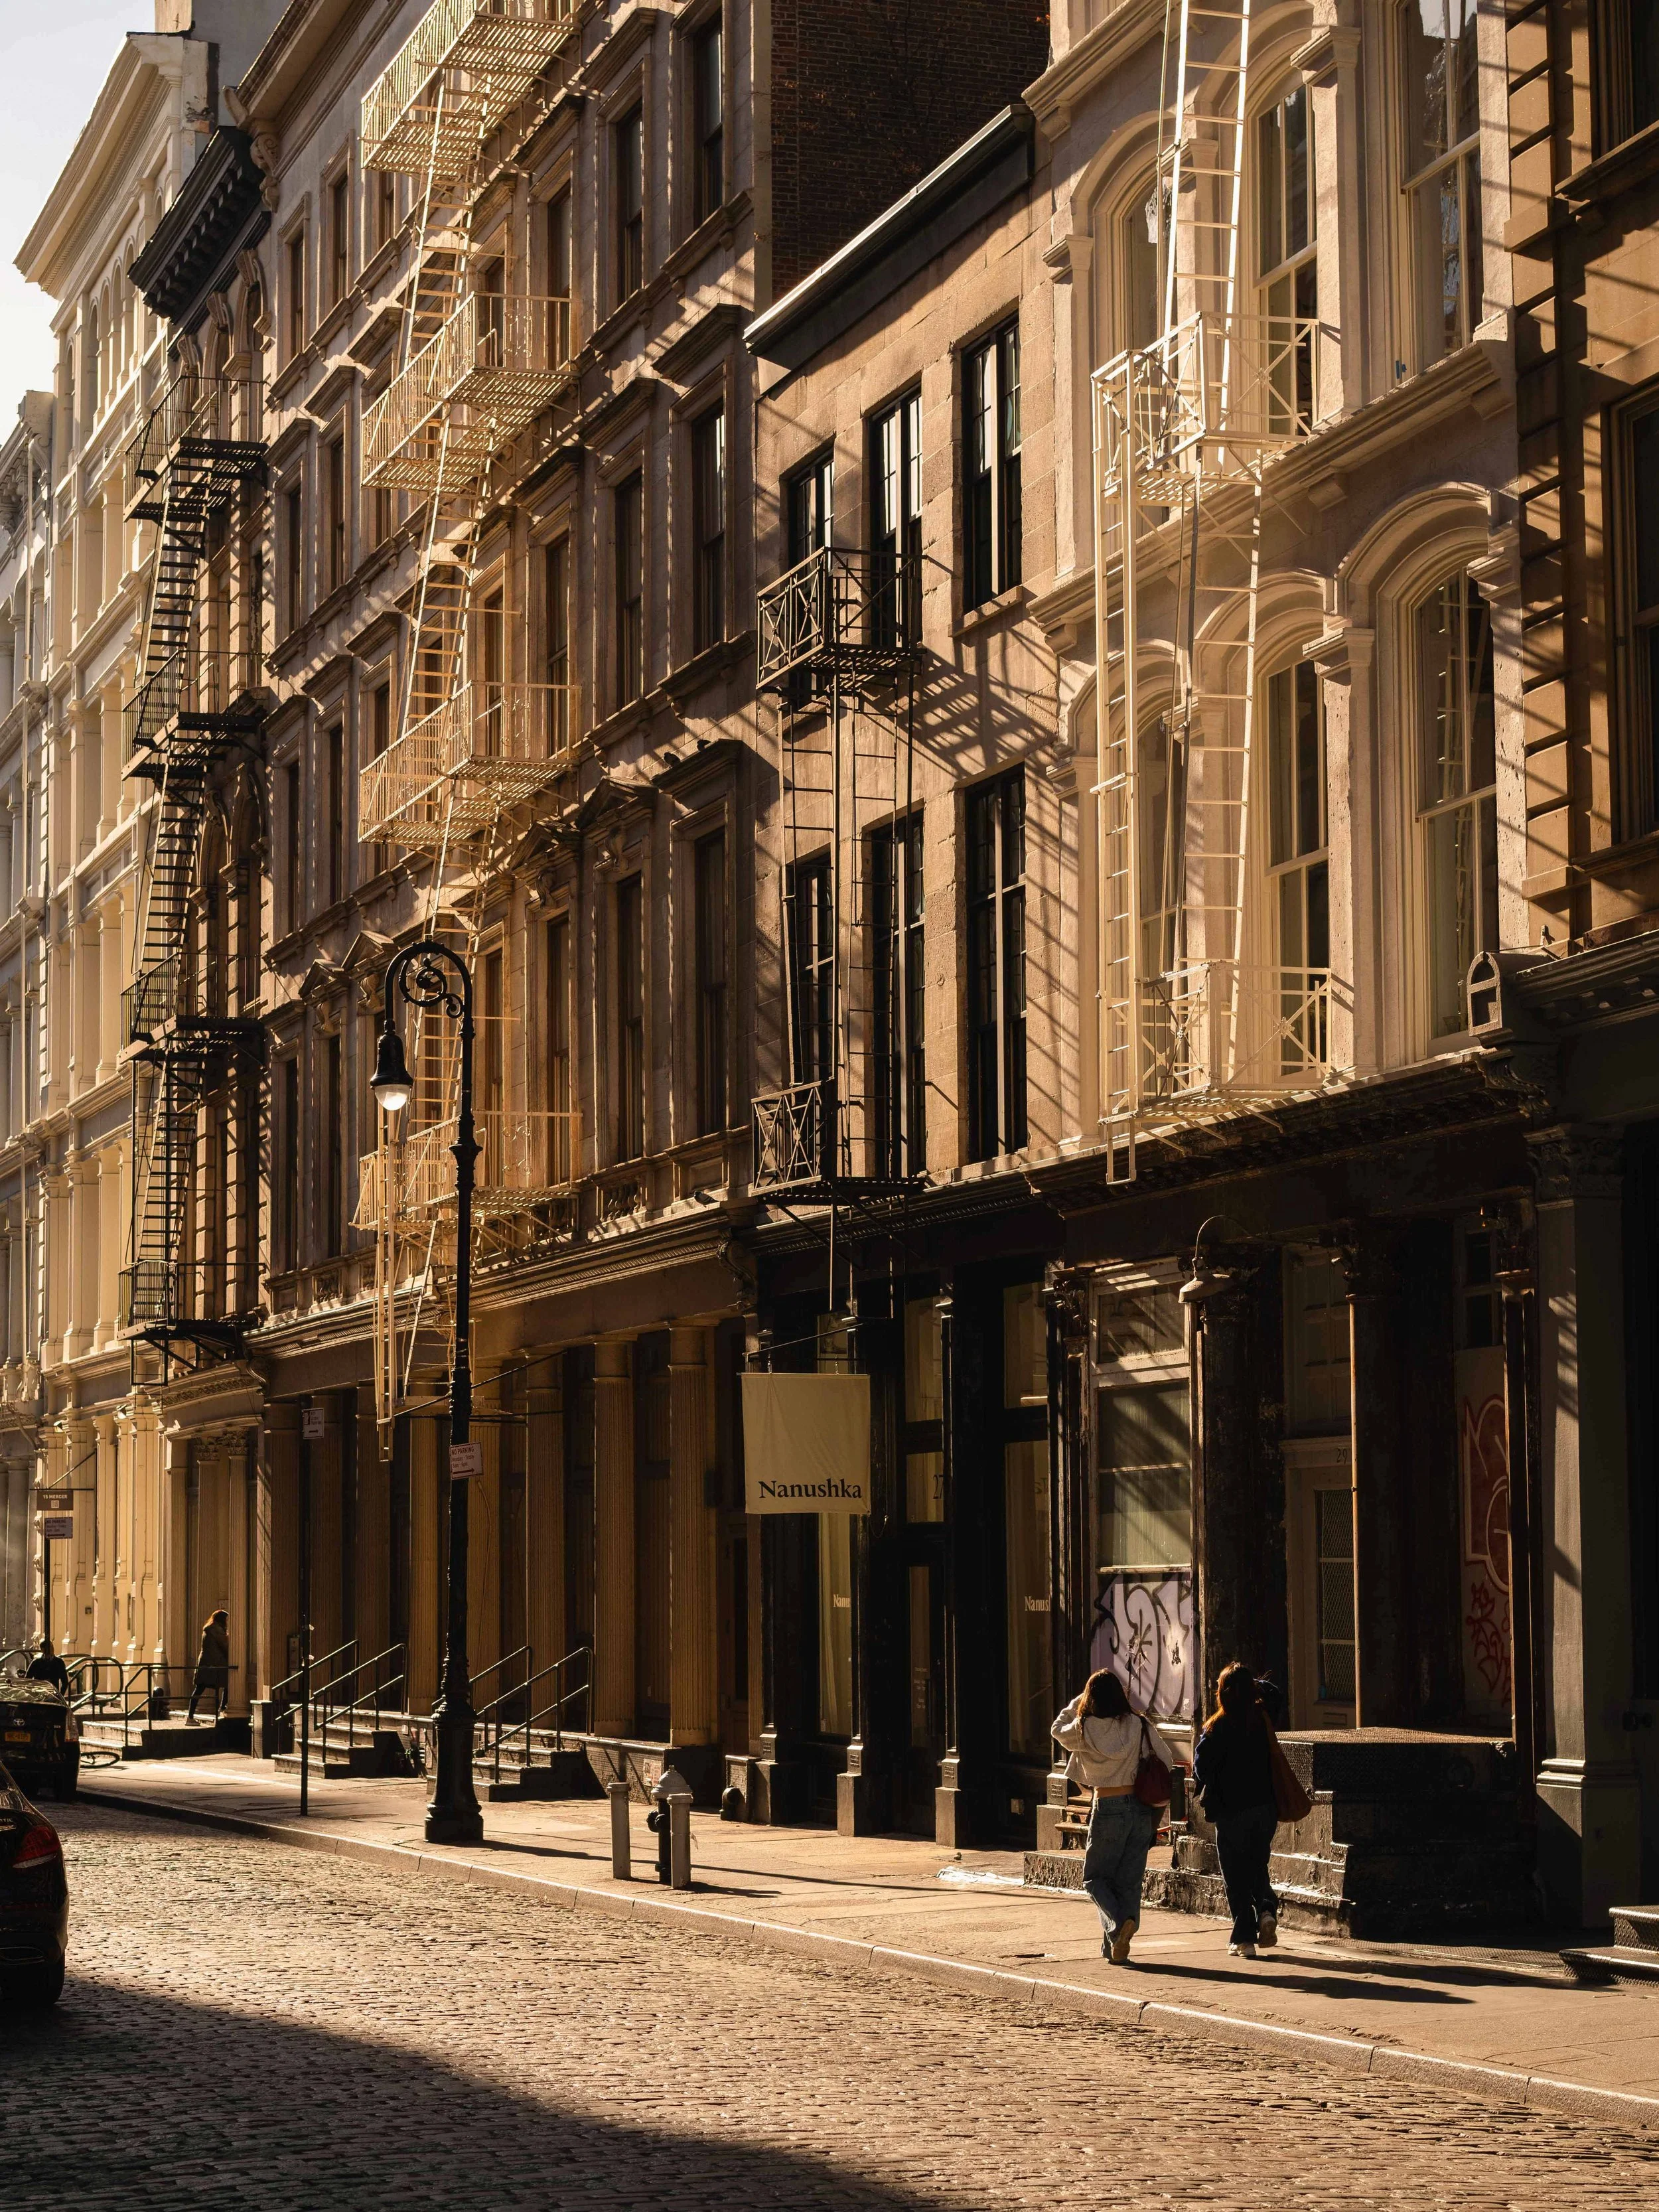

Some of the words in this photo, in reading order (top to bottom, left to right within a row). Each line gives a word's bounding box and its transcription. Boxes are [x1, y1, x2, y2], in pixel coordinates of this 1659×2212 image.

[1336, 1448, 1347, 1465] 29
[758, 1479, 863, 1499] Nanushka
[932, 1475, 944, 1499] 27
